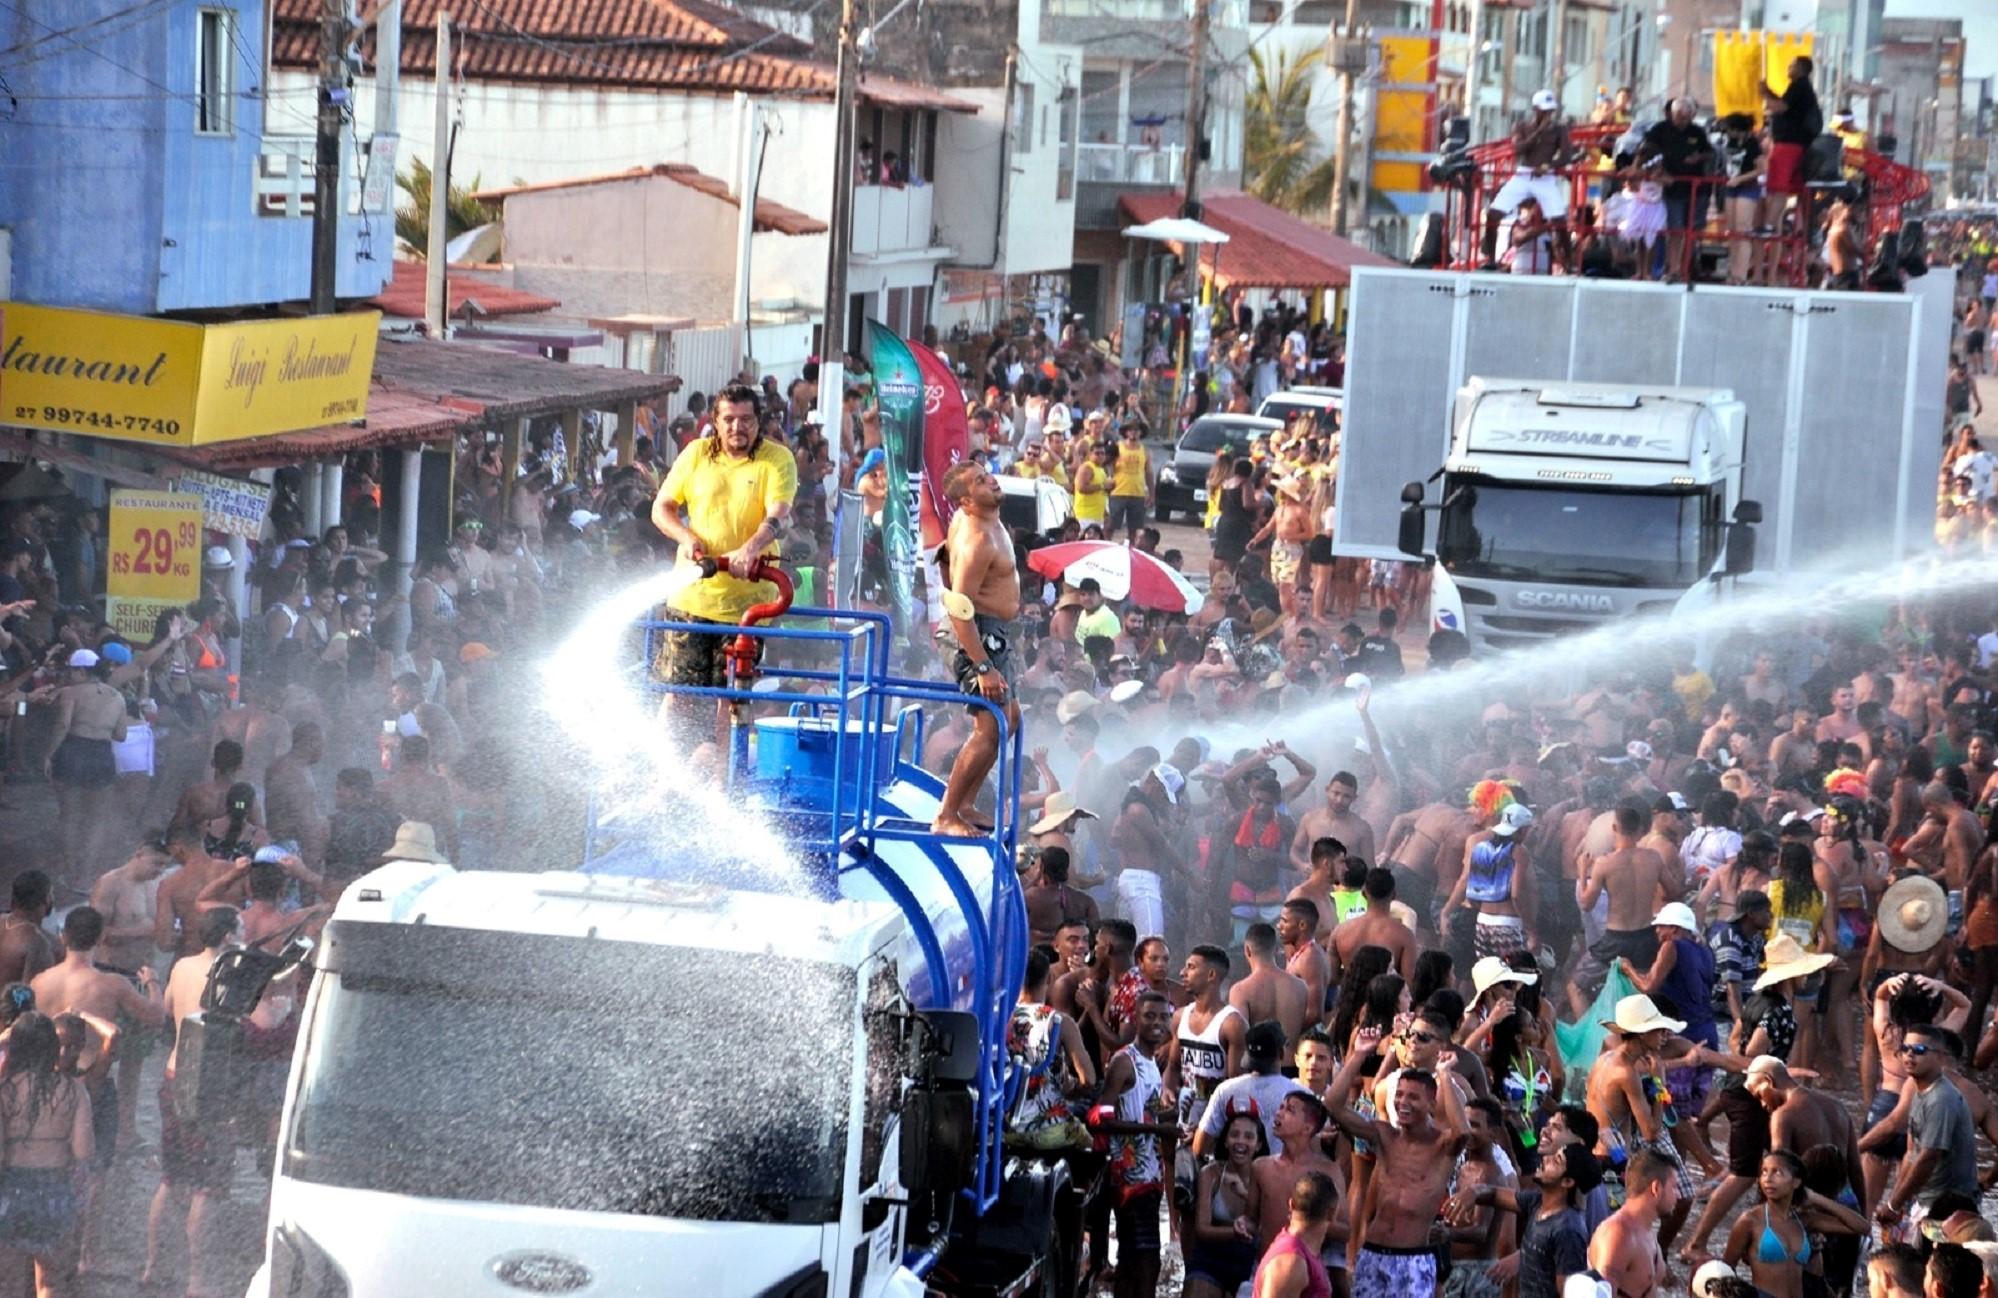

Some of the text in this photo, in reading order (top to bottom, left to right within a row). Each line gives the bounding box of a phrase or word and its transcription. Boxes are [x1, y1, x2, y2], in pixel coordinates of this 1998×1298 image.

[15, 406, 181, 435] 27 99744-7740
[1518, 429, 1643, 449] STREAMLINE
[115, 499, 198, 511] RESTAURANTE
[221, 503, 260, 523] MENSAL
[112, 552, 130, 575] R$
[173, 563, 190, 577] KG
[1517, 590, 1614, 611] SCANIA
